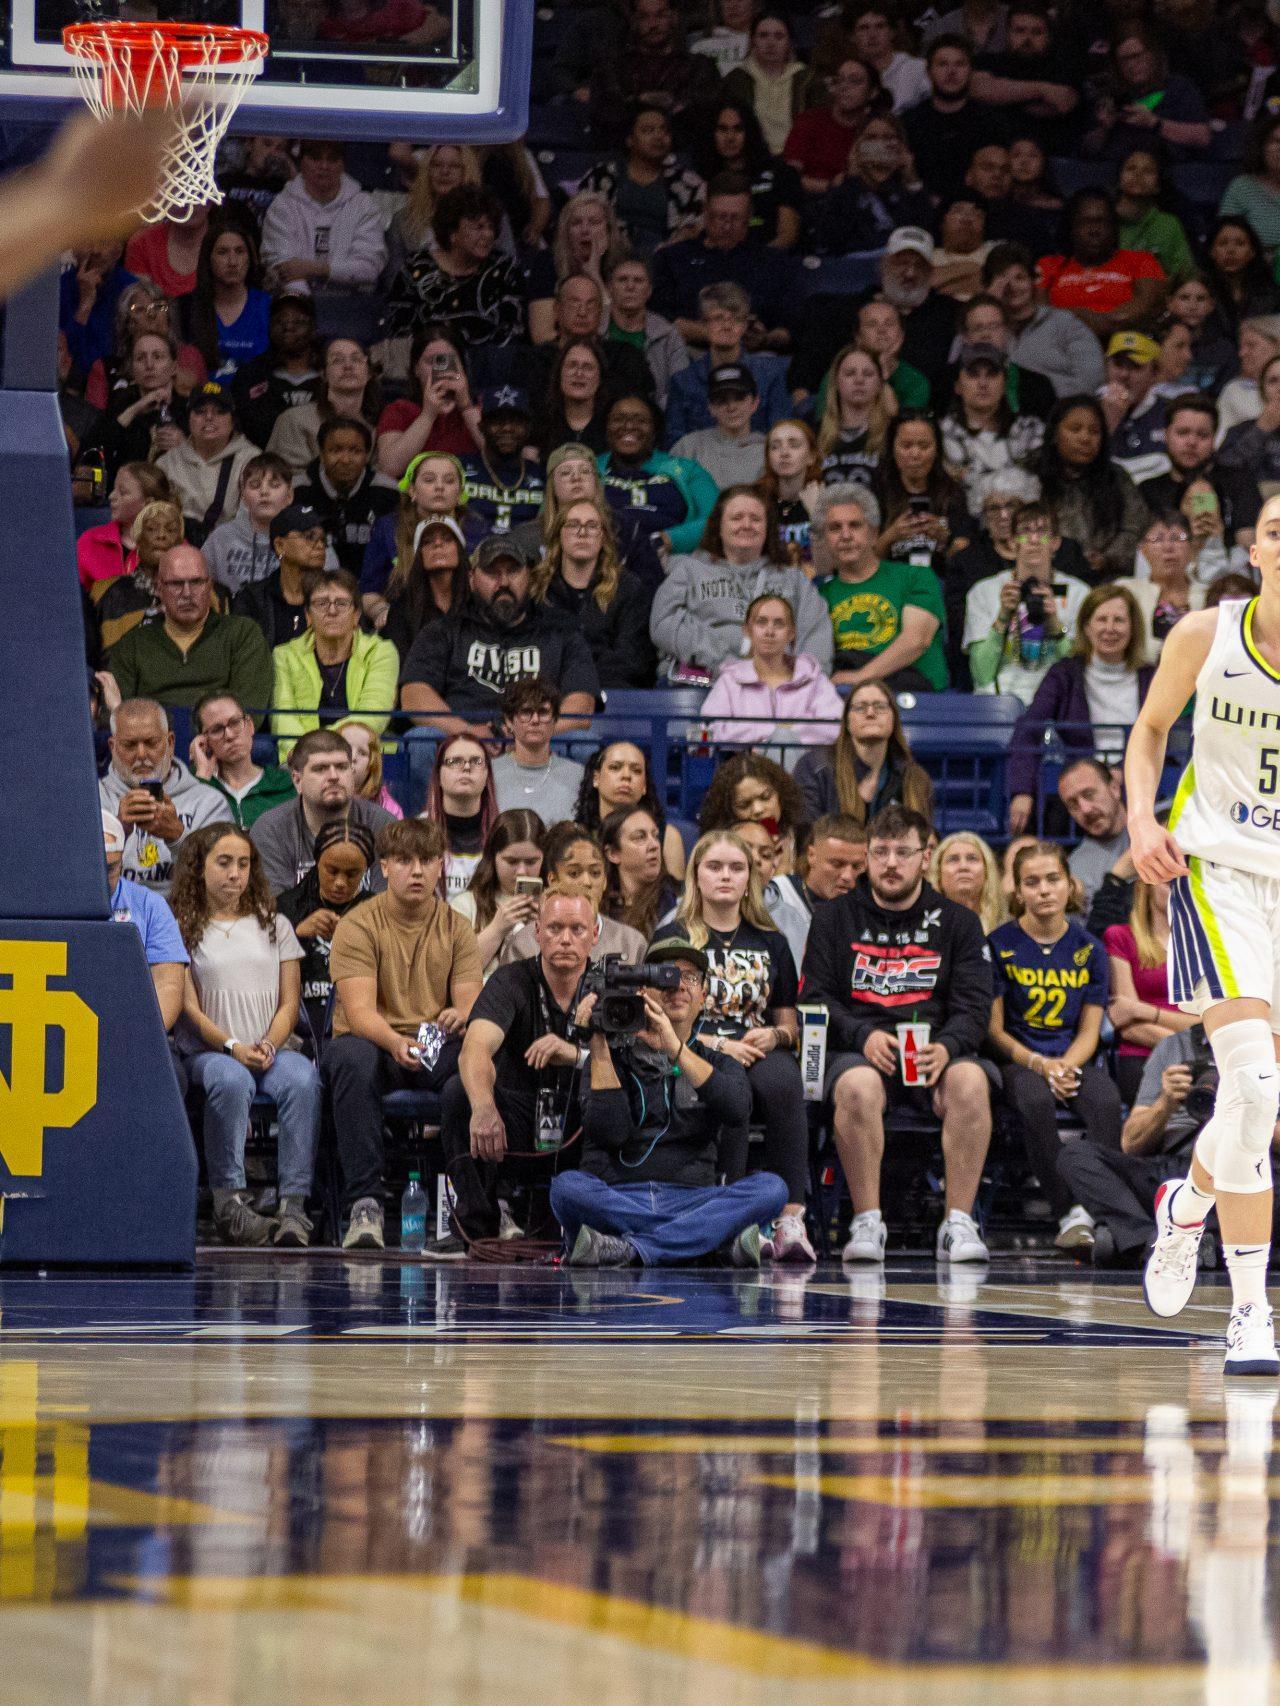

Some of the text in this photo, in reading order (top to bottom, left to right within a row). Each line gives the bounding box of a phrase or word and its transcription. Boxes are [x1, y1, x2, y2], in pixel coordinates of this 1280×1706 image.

[465, 481, 545, 504] DALLAS
[467, 640, 540, 675] GVSU
[1258, 747, 1280, 796] 5
[705, 948, 771, 983] UST
[1005, 963, 1091, 988] INDIANA
[1024, 987, 1068, 1029] 22
[806, 1044, 821, 1083] POPCORN
